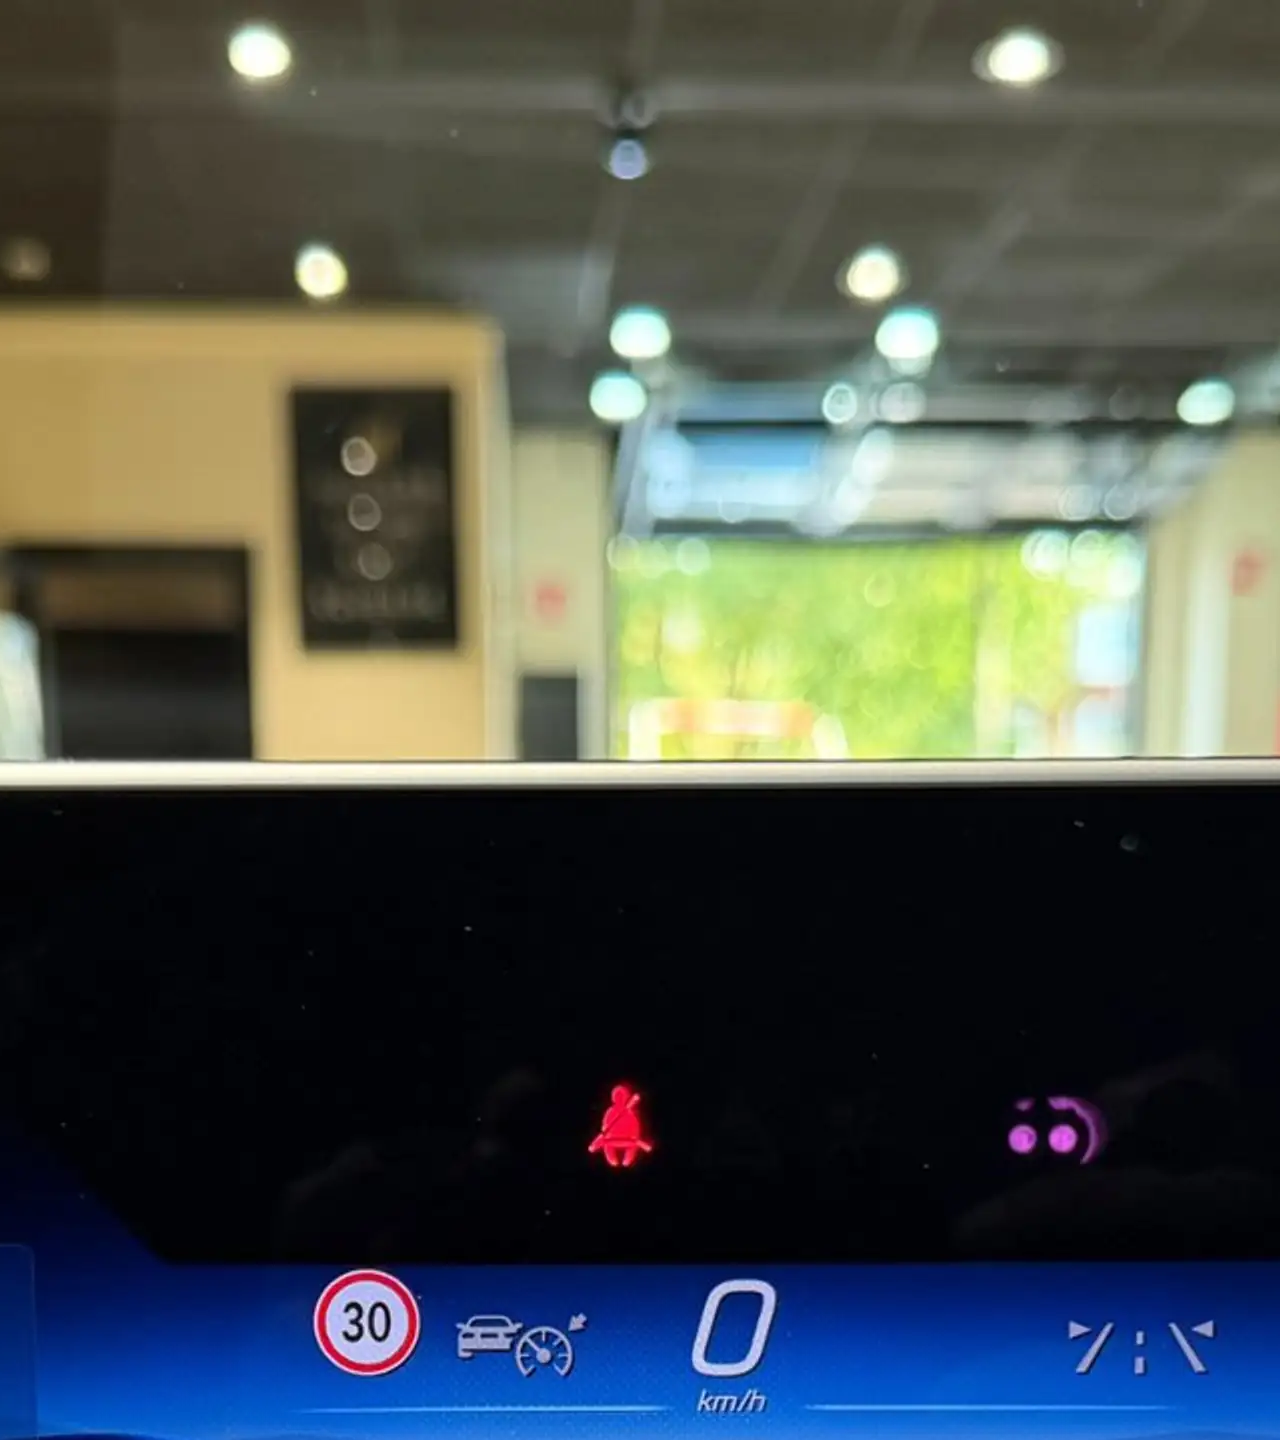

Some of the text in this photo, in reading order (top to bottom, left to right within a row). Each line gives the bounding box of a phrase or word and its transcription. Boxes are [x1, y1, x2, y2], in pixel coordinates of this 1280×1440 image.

[341, 1301, 391, 1343] 30
[691, 1278, 777, 1377] 0
[698, 1389, 766, 1414] km/h
